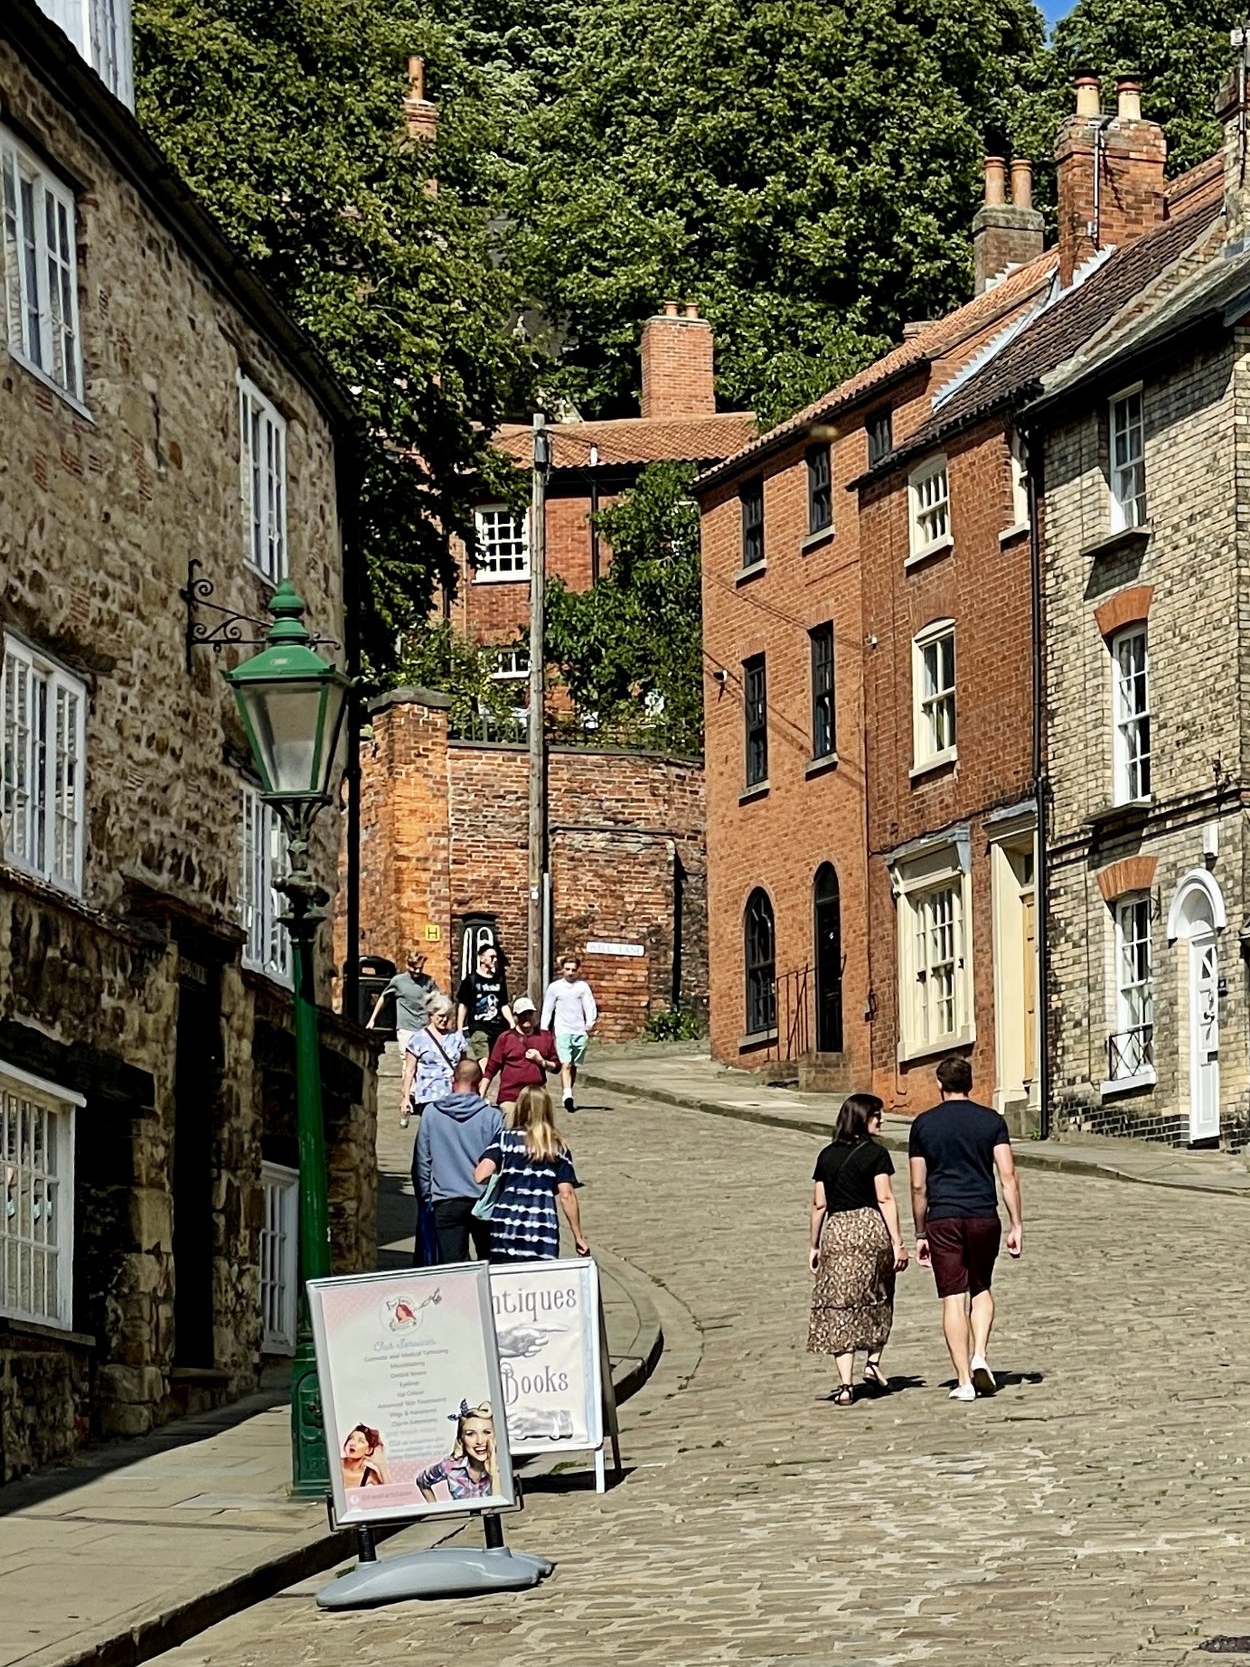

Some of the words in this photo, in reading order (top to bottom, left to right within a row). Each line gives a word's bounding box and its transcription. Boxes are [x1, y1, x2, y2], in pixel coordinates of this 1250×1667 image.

[427, 927, 438, 939] H
[589, 943, 613, 953] WELL
[492, 1287, 577, 1322] ntiques
[500, 1362, 569, 1406] Books
